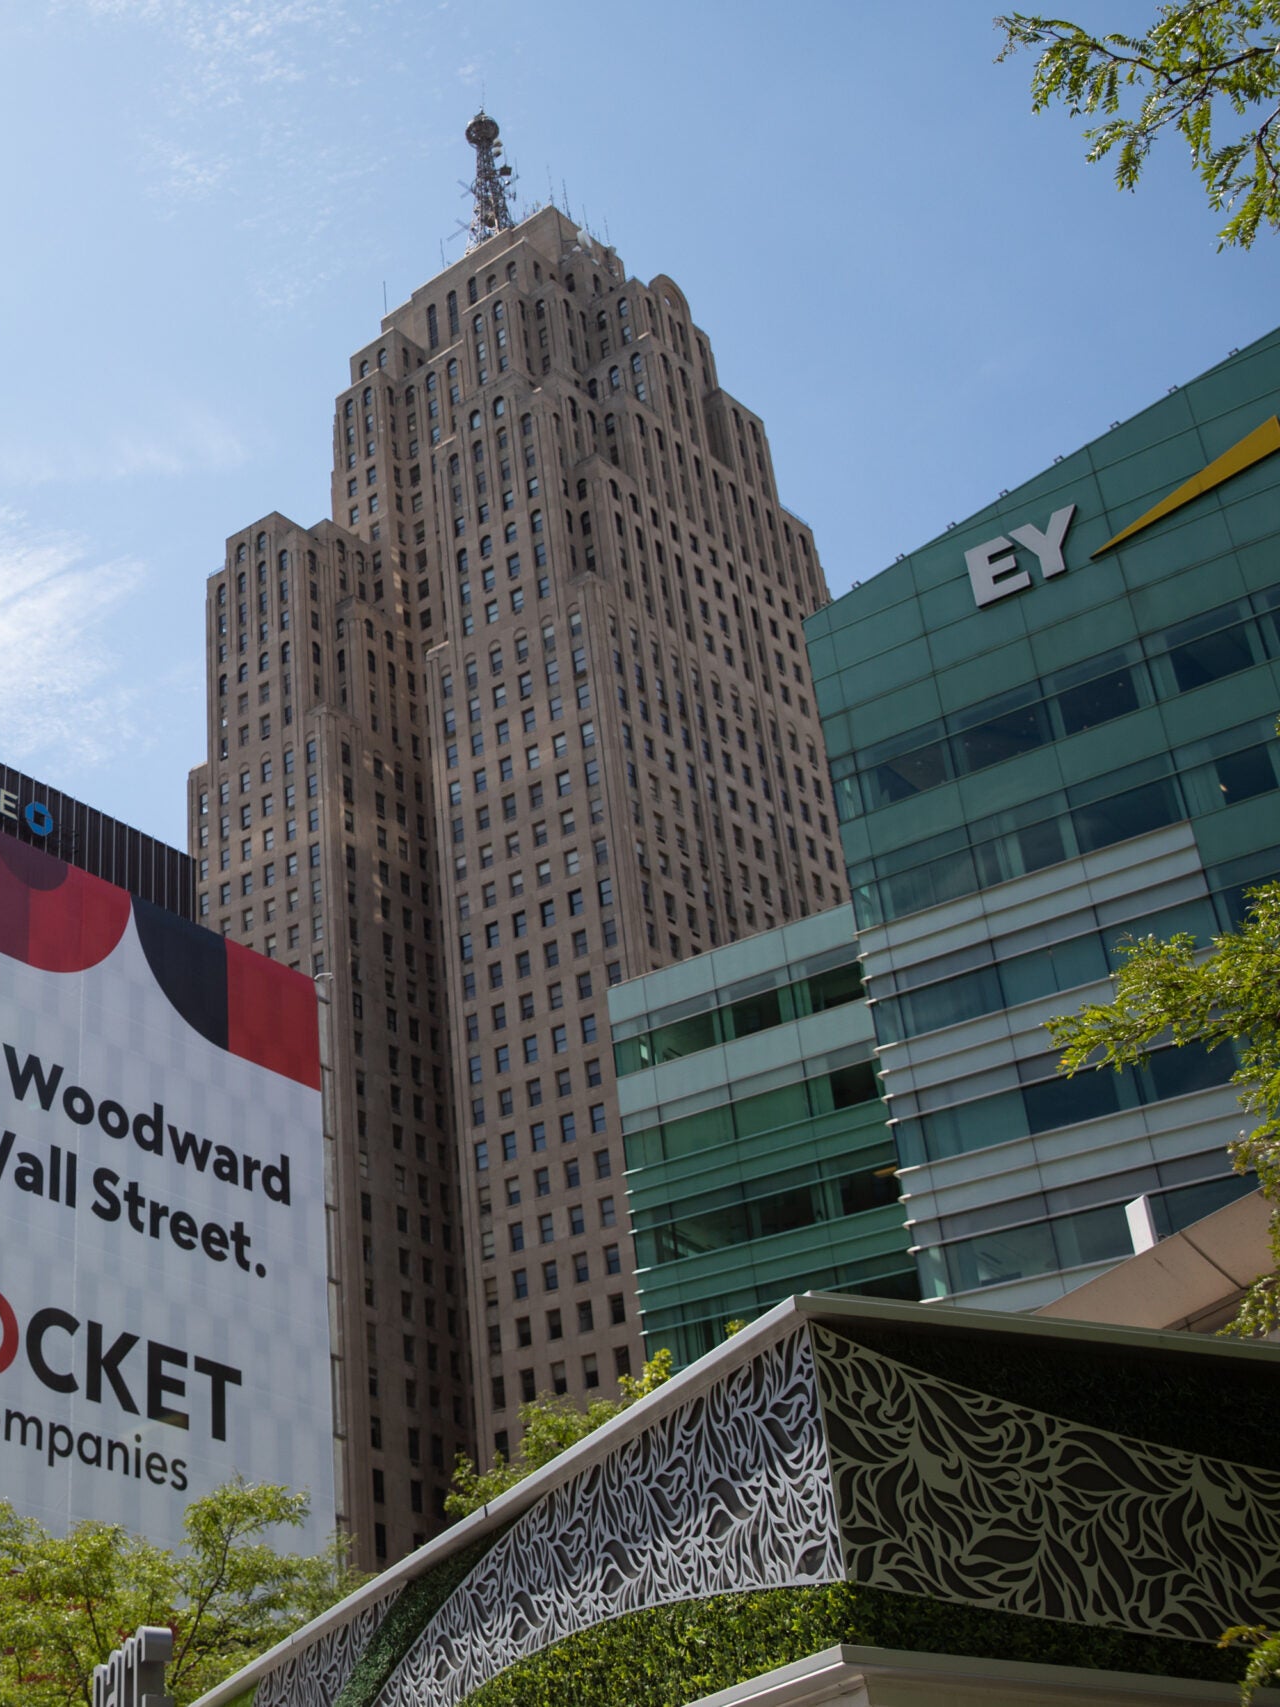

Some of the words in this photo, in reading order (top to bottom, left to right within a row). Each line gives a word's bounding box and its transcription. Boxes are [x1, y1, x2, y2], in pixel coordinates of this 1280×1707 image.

[963, 503, 1077, 609] EY
[3, 1042, 291, 1206] Woodward
[91, 1167, 267, 1278] Street.
